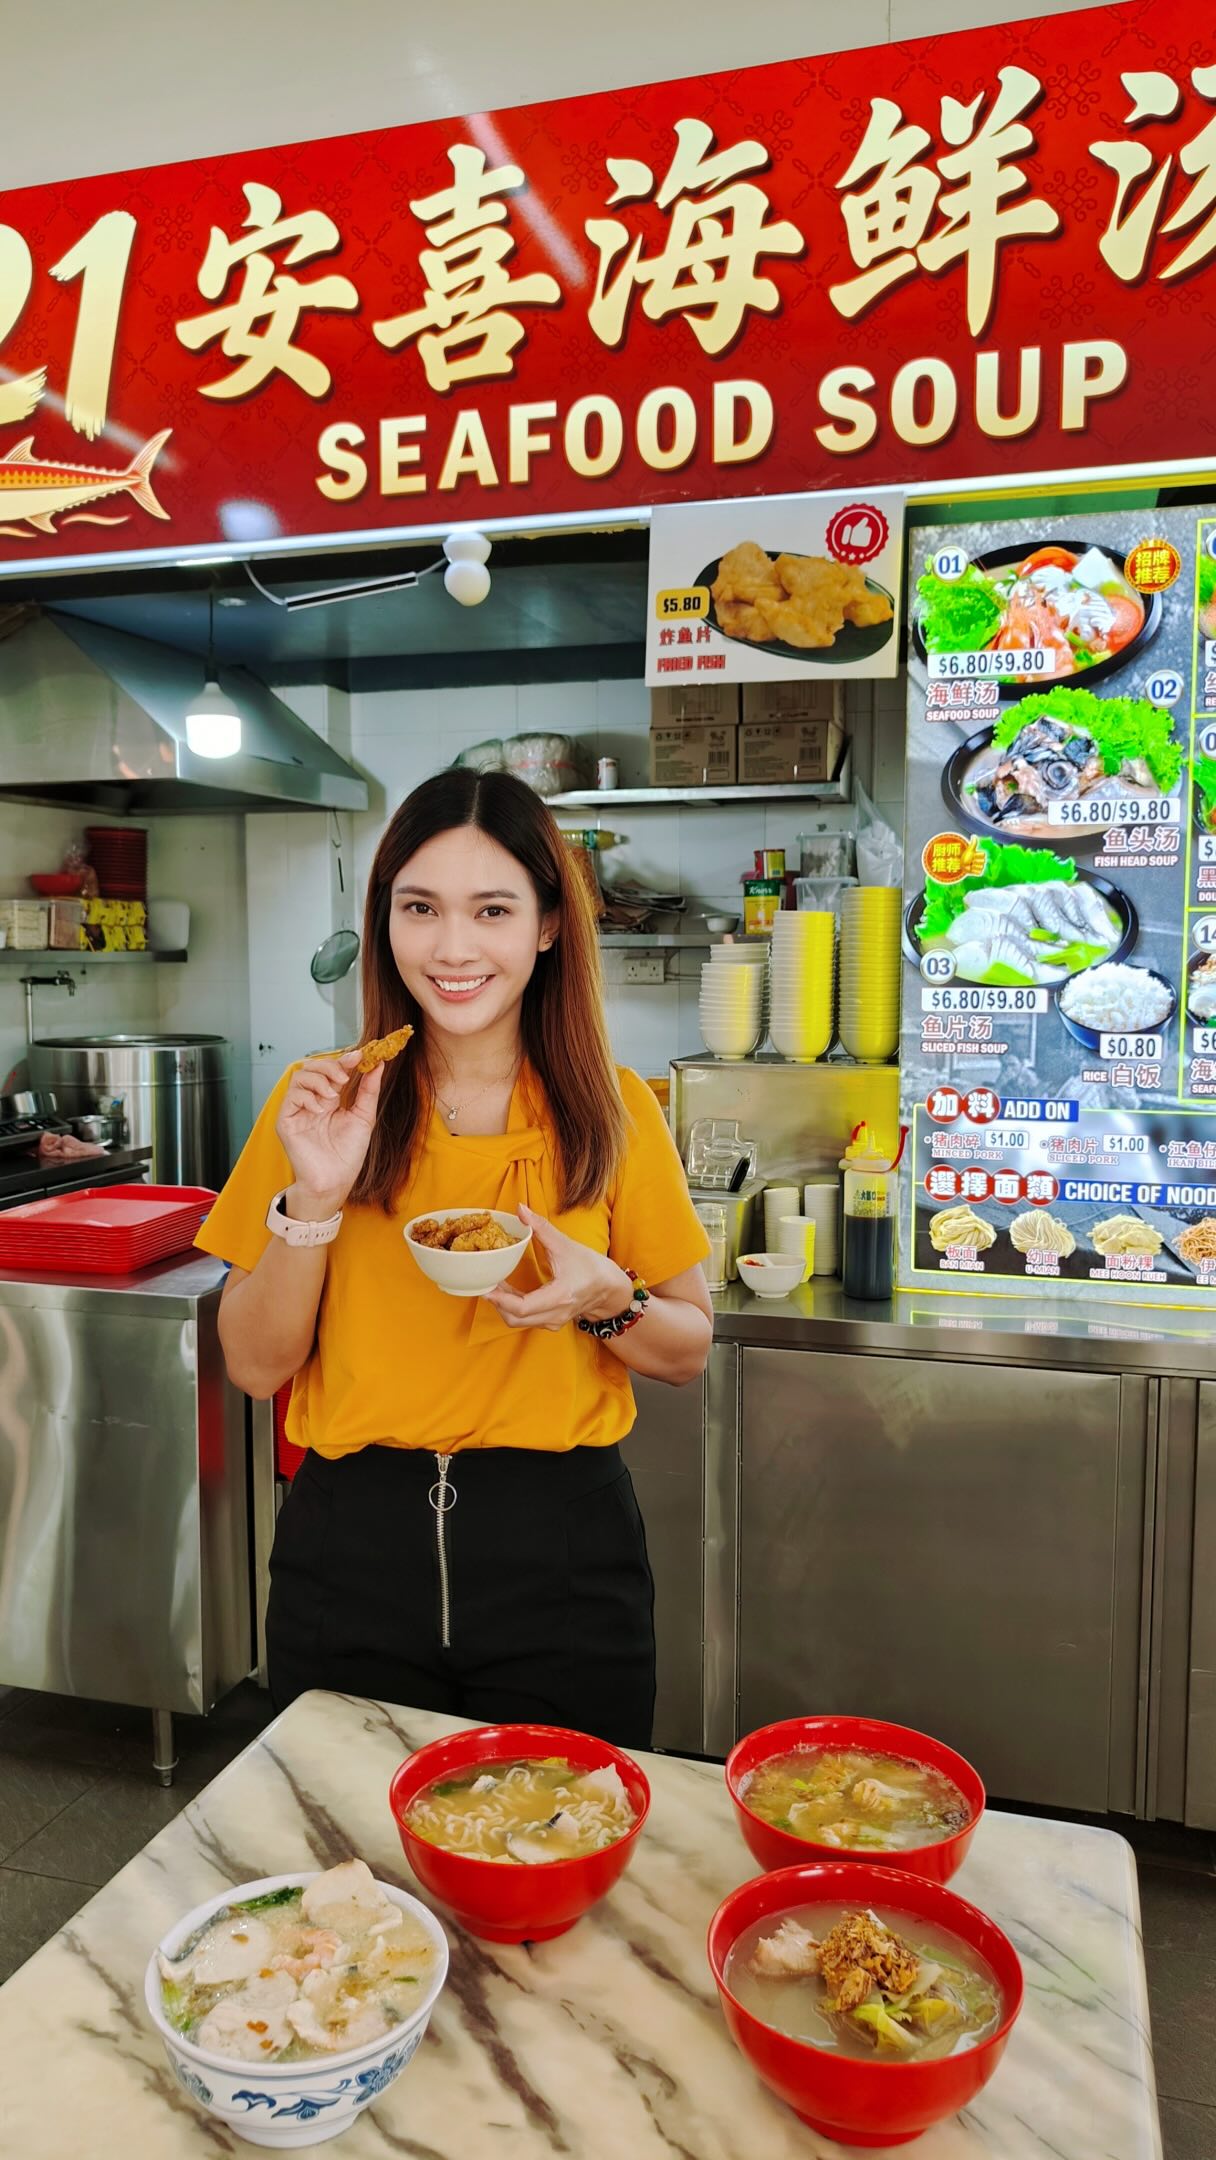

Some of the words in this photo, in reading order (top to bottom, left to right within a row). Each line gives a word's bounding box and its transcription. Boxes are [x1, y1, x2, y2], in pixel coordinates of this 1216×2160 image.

[315, 380, 773, 500] SEAFOOD
[815, 340, 1128, 454] SOUP
[938, 555, 961, 574] 01
[1136, 550, 1170, 567] 招牌
[1136, 567, 1170, 584] 推荐
[664, 596, 701, 613] $5.80
[939, 650, 1045, 674] $6.80/$9.80
[926, 680, 999, 706] 海鲜汤
[1152, 679, 1177, 700] 02
[926, 709, 971, 721] SEAFOOD
[972, 708, 999, 719] SOUP
[1060, 800, 1171, 823] $6.80/$9.80
[1103, 826, 1180, 852] 鱼头汤
[932, 843, 961, 857] 厨师
[932, 857, 961, 873] 推荐
[1094, 857, 1118, 867] FISH
[1119, 856, 1147, 866] HEAD
[1149, 856, 1178, 866] SOUP
[926, 958, 950, 976] 03
[931, 990, 1036, 1010] $6.80/$9.80
[921, 1015, 993, 1041] 鱼片汤
[921, 1042, 955, 1053] SLICED
[957, 1043, 980, 1053] FISH
[981, 1044, 1008, 1054] SOUP
[1108, 1037, 1156, 1057] $0.80
[1082, 1070, 1108, 1083] RICE
[1112, 1063, 1161, 1088] 白饭
[932, 1092, 995, 1118] 加料
[1004, 1101, 1040, 1119] ADD
[1045, 1102, 1070, 1120] ON
[991, 1133, 1024, 1147] $1.00
[1049, 1136, 1098, 1153] 猪肉片
[1109, 1138, 1144, 1151] $1.00
[932, 1149, 972, 1159] MINCED
[974, 1150, 1003, 1160] PORK
[1048, 1154, 1087, 1163] SLICED
[1088, 1155, 1119, 1165] PORK
[1065, 1182, 1132, 1202] CHOICE
[1138, 1185, 1162, 1204] OF
[946, 1245, 977, 1260] 板面
[1026, 1249, 1058, 1265] 幼面
[940, 1259, 958, 1269] BAN
[959, 1261, 984, 1271] MIAN
[1089, 1268, 1110, 1278] MEE
[1110, 1269, 1141, 1280] HOON
[1141, 1272, 1167, 1282] KUEH
